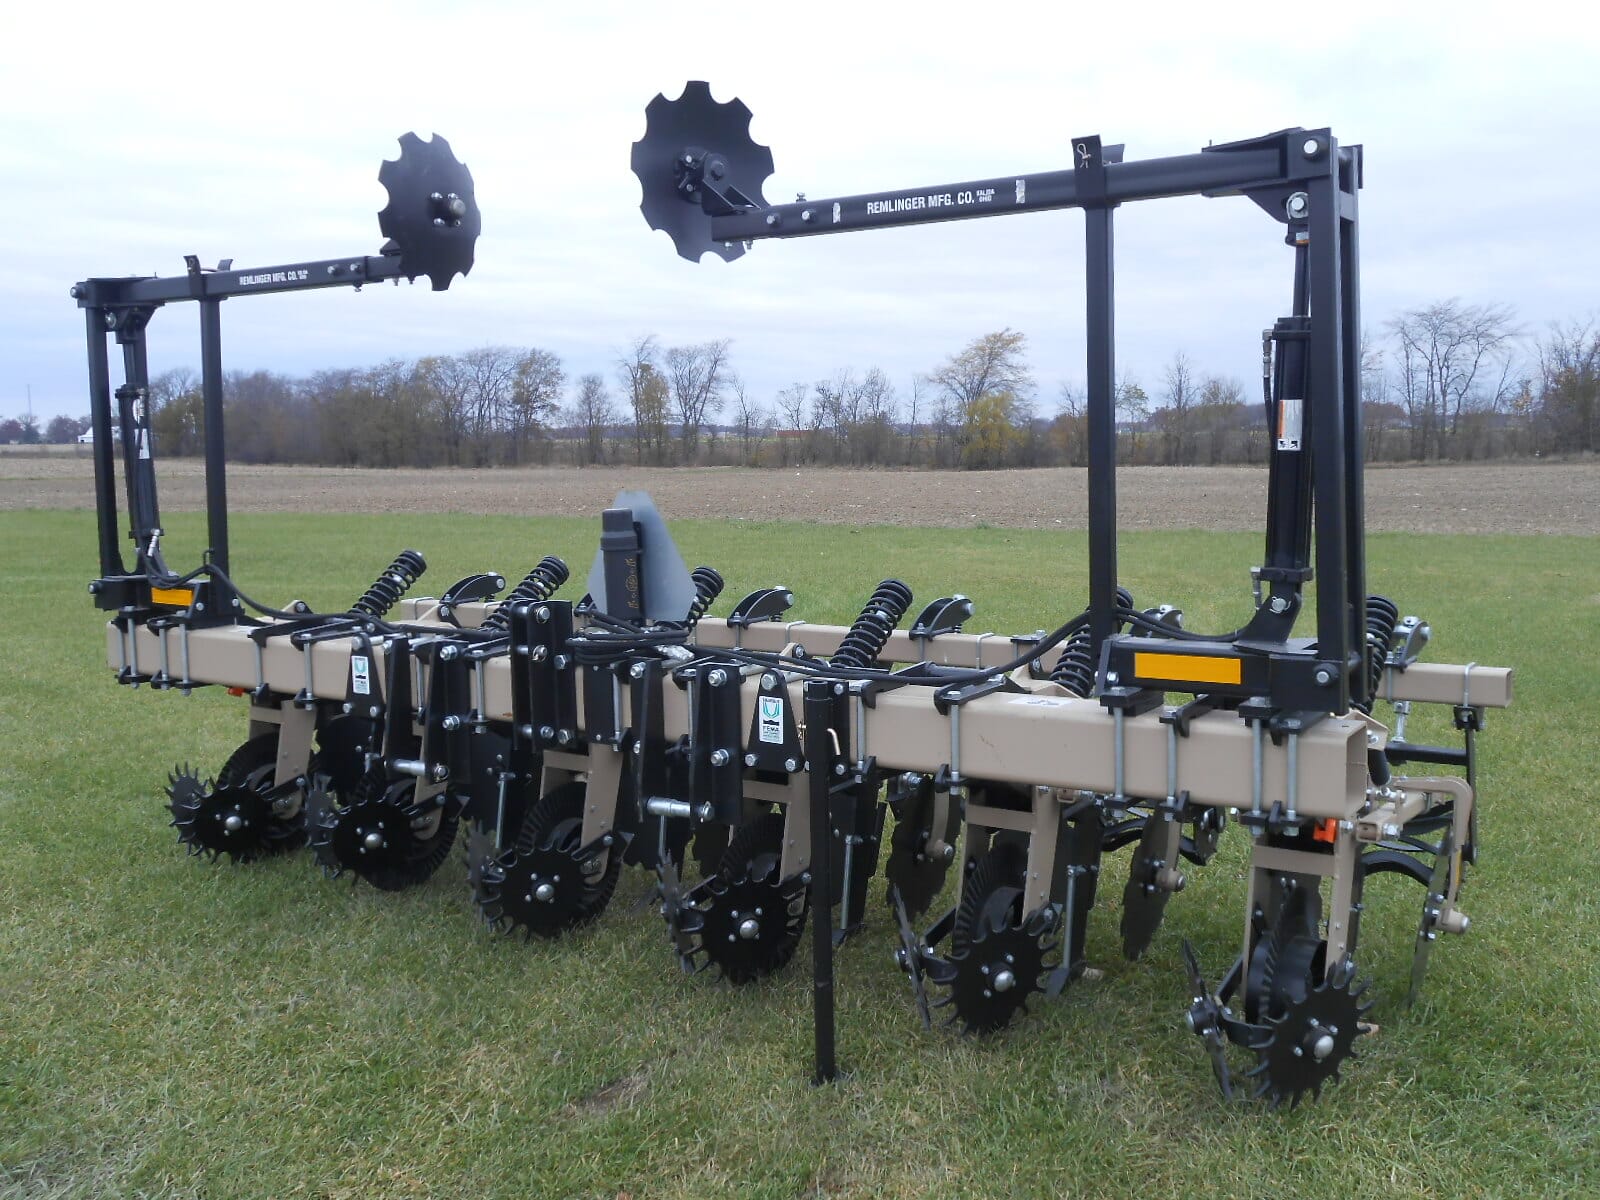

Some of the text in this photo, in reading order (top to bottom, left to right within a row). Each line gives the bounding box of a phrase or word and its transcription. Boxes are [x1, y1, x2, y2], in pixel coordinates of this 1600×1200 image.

[867, 191, 975, 215] REMLINGER MFG. CO.
